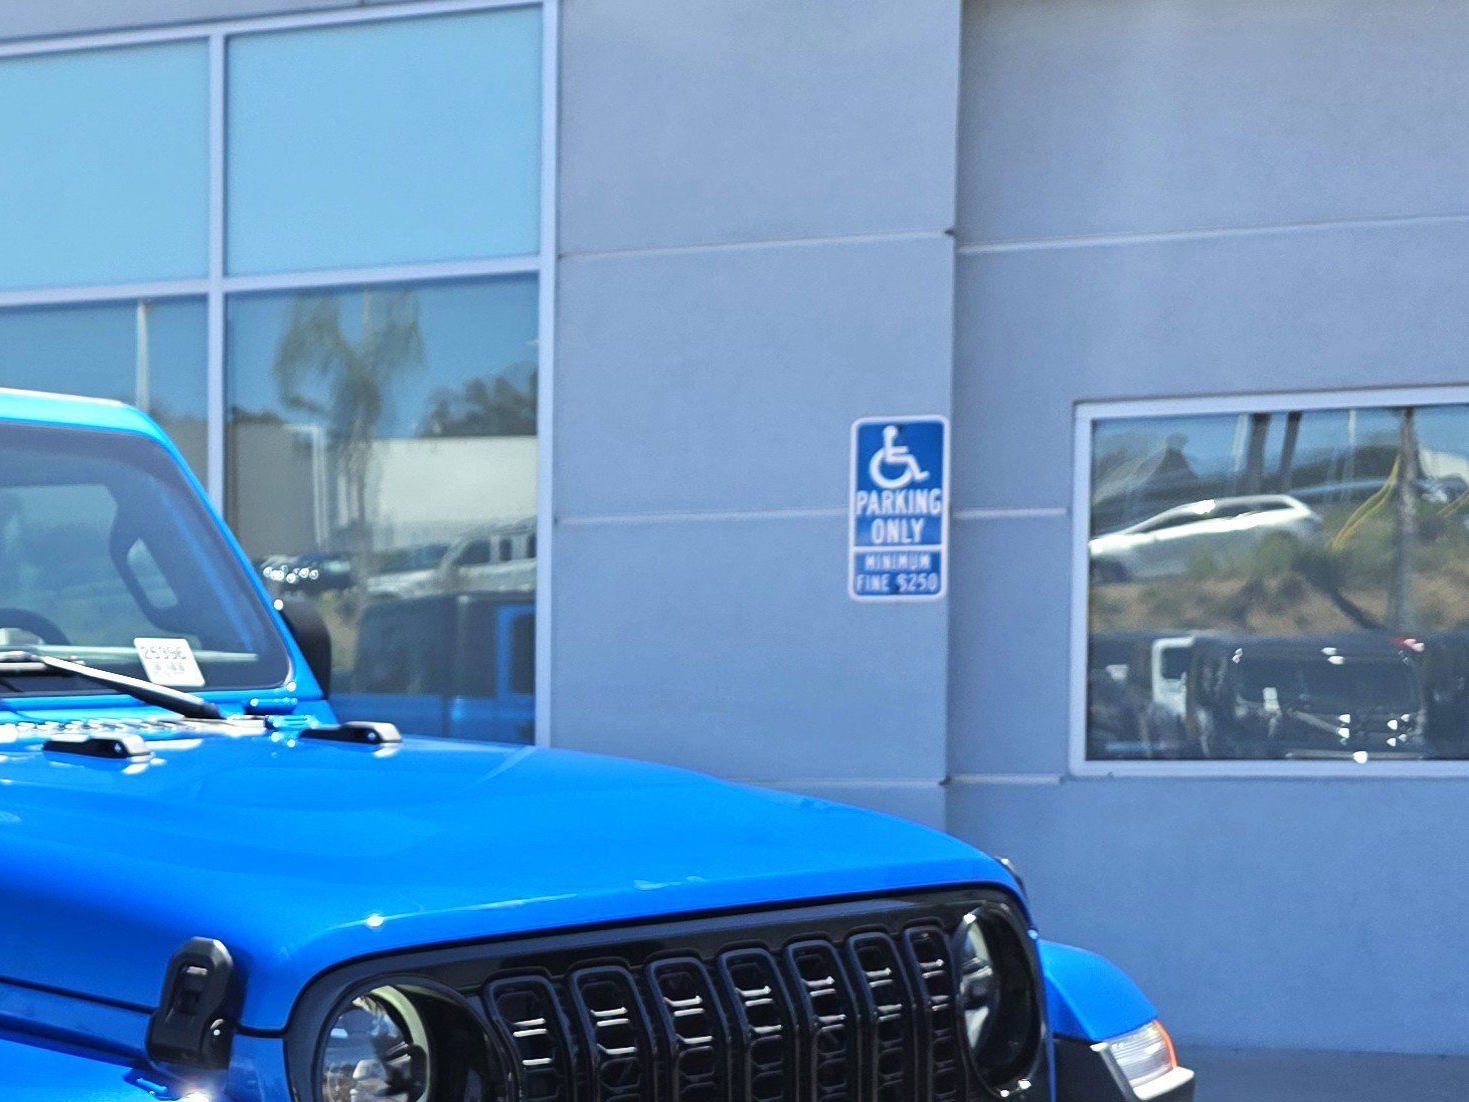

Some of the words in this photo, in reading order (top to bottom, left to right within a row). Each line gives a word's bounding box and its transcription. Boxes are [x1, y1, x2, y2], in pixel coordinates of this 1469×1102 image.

[855, 488, 941, 515] PARKING
[871, 518, 924, 544] ONLY
[865, 553, 930, 570] MINIMUM
[856, 574, 890, 591] FINE
[897, 572, 938, 592] $250
